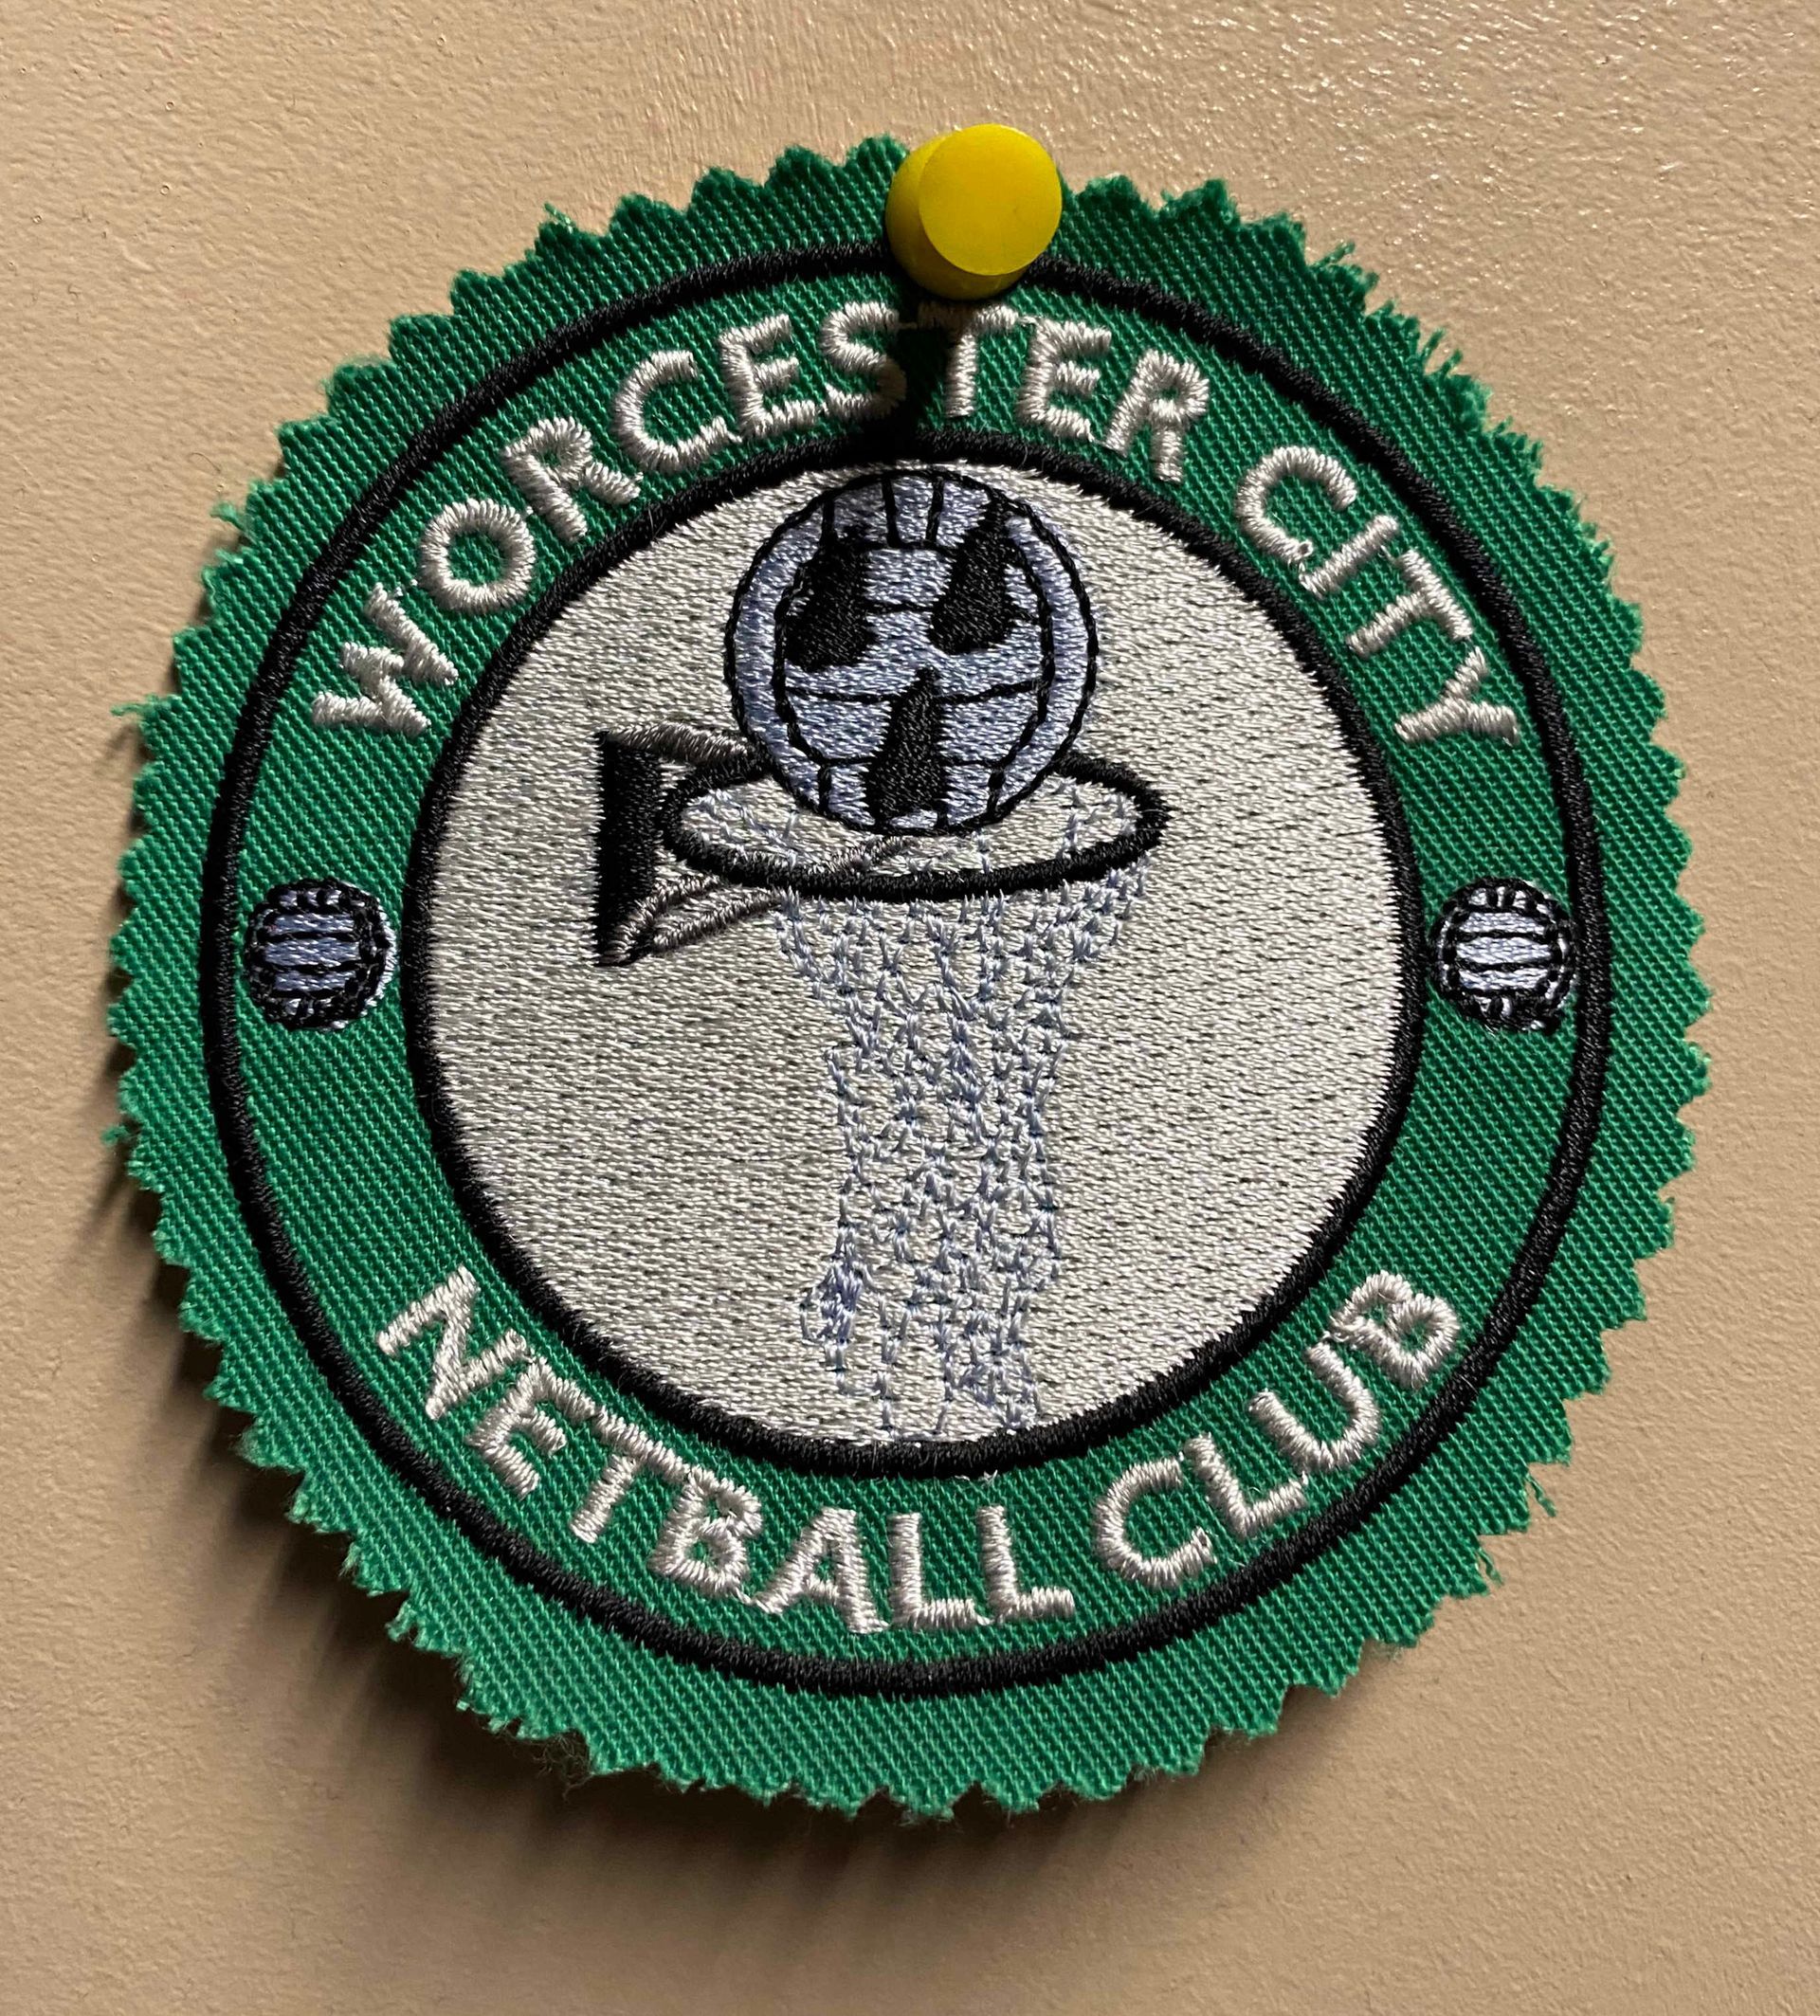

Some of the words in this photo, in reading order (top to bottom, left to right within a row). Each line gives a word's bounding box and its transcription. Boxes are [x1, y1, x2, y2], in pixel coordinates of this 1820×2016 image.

[312, 301, 1210, 736] WORCESTER
[1235, 445, 1520, 749] CITY
[376, 1263, 1076, 1635] NETBALL
[1097, 1270, 1464, 1585] CLUB
